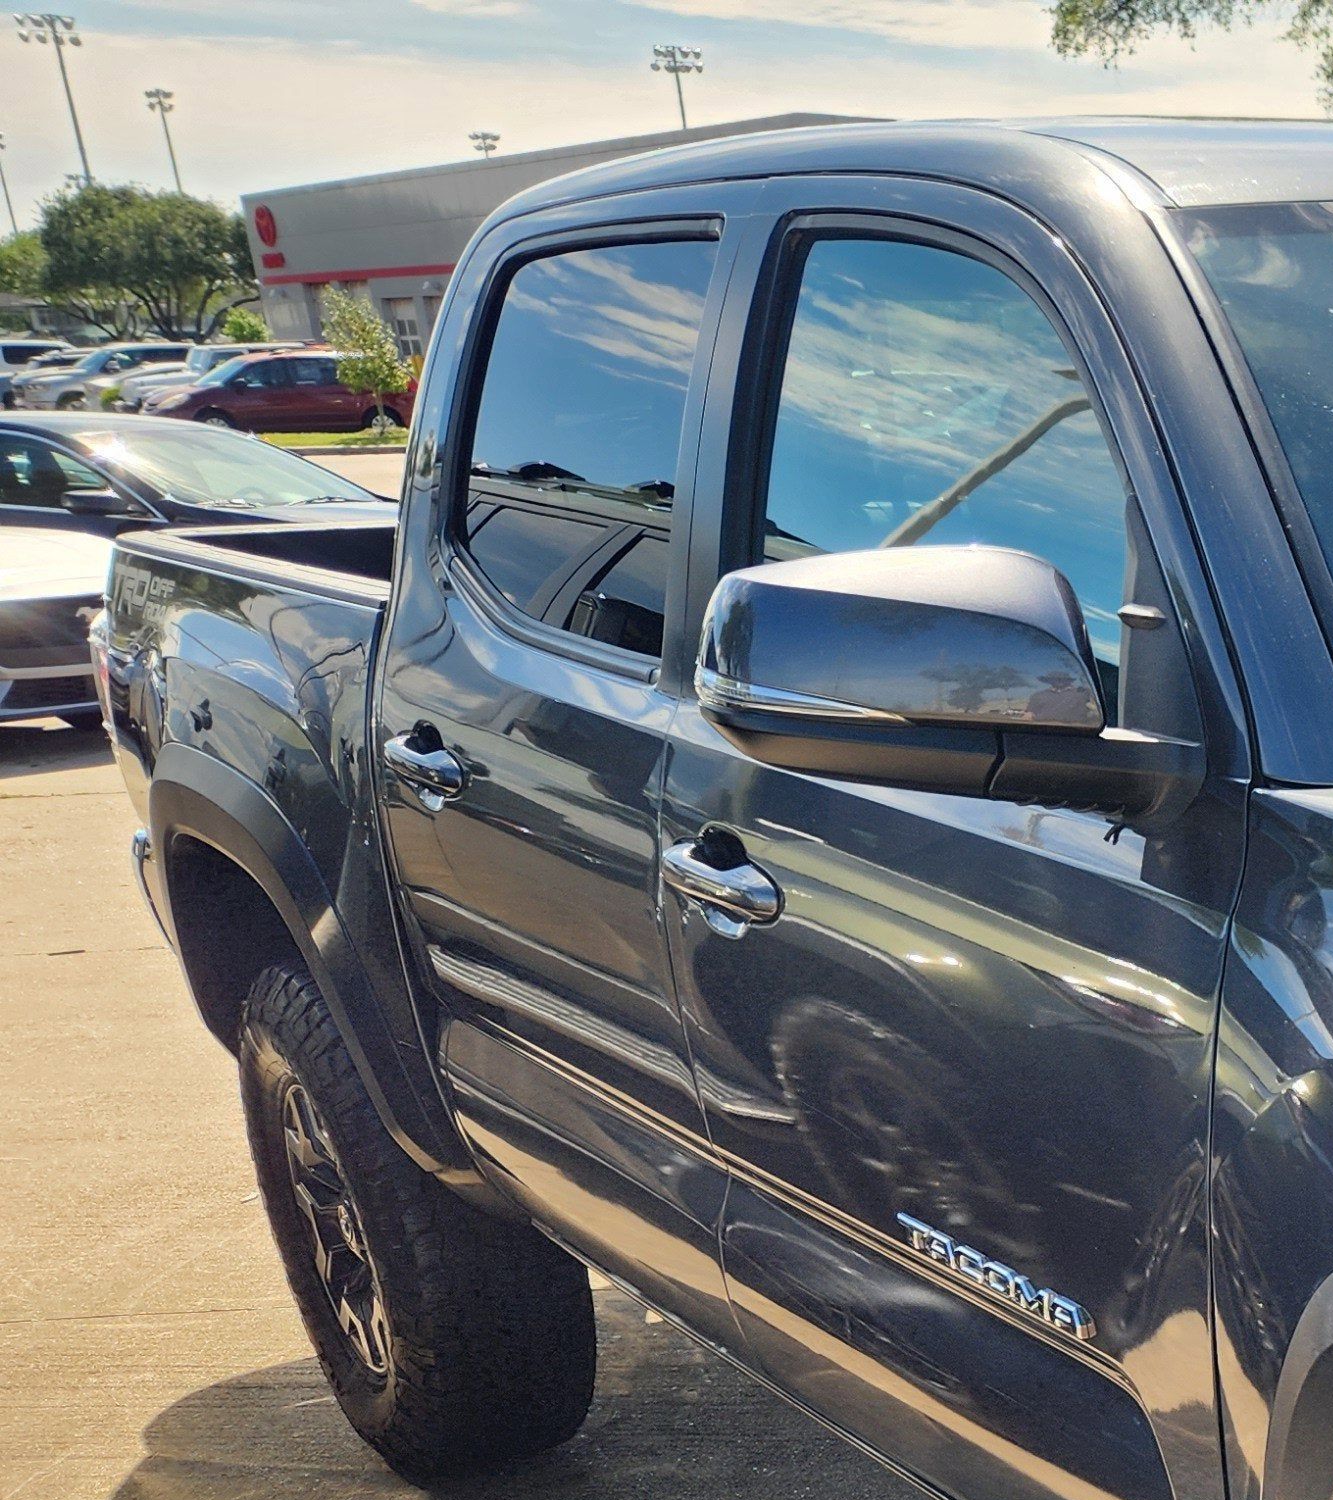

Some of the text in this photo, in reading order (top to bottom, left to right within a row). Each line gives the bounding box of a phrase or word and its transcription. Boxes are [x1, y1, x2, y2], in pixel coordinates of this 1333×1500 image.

[112, 562, 151, 616] TRD
[149, 575, 176, 598] OFF
[142, 600, 172, 622] ROA
[896, 1211, 1097, 1341] TACOMA
